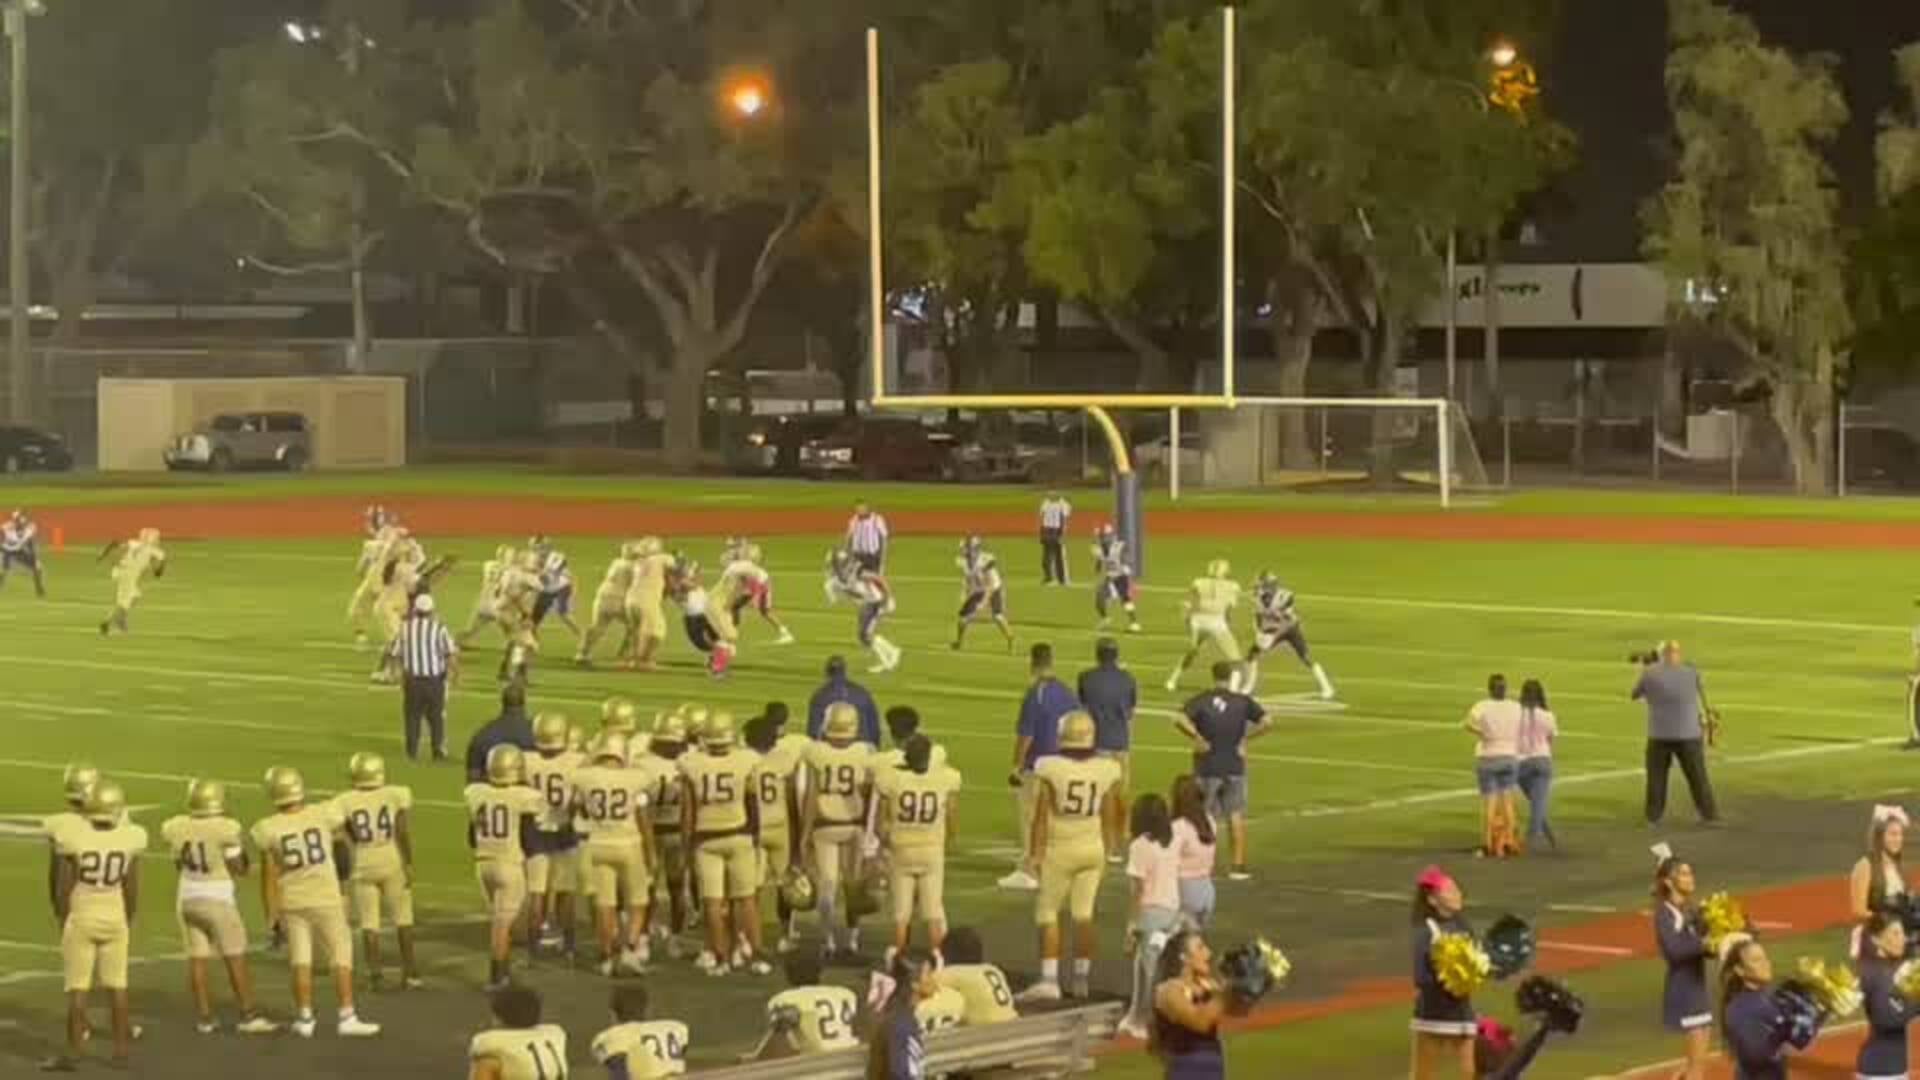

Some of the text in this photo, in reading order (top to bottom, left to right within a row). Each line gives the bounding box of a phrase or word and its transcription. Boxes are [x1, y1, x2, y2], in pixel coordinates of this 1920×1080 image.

[702, 773, 734, 804] 15
[821, 764, 855, 797] 19
[1064, 780, 1097, 817] 51
[476, 804, 509, 840] 40
[590, 788, 628, 821] 32
[897, 790, 938, 825] 90
[350, 806, 392, 844] 84
[179, 841, 209, 875] 41
[280, 827, 326, 874] 58
[78, 851, 127, 887] 20
[983, 970, 1009, 1006] 8
[527, 1040, 566, 1080] 11
